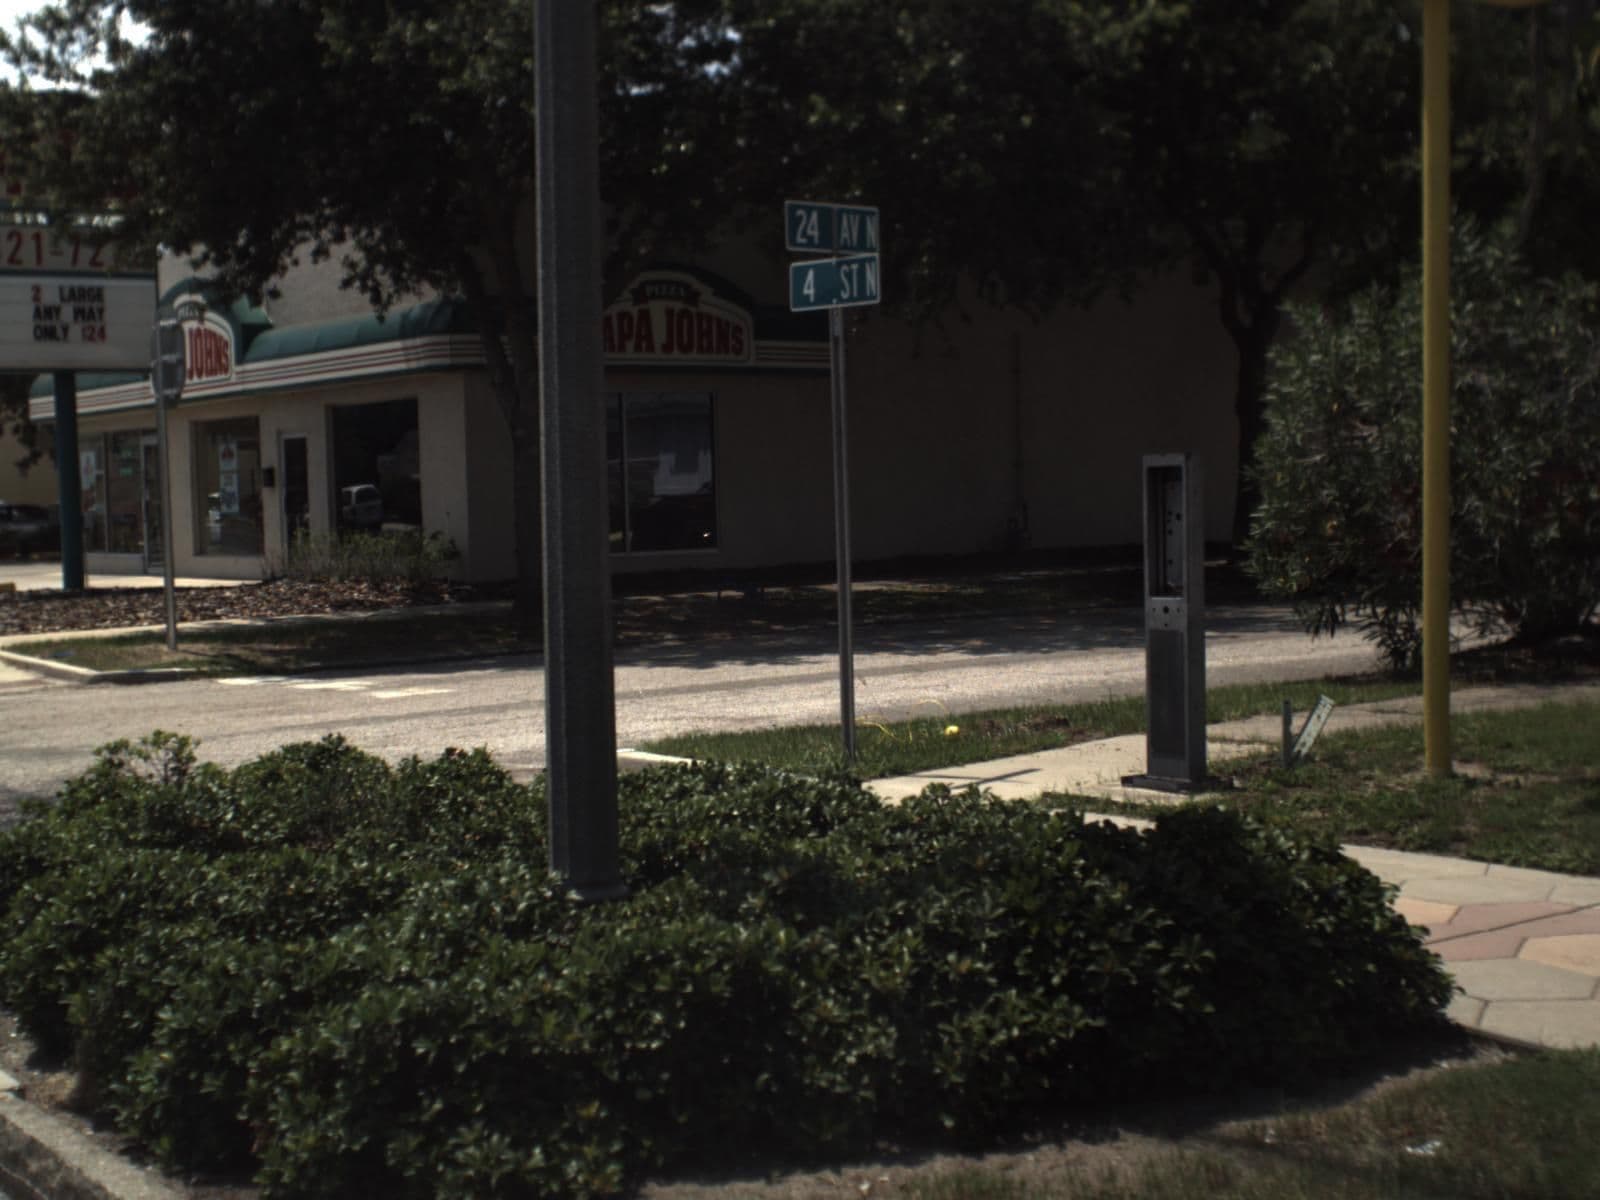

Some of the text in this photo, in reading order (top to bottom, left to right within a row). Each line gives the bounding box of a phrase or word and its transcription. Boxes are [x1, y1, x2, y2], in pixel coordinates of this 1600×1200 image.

[794, 208, 877, 249] 24 AV N
[31, 285, 105, 304] 2 LARGE
[803, 260, 877, 303] 4 ST N
[33, 305, 105, 322] ANY WAY
[33, 324, 69, 342] ONLY
[603, 308, 656, 352] APA
